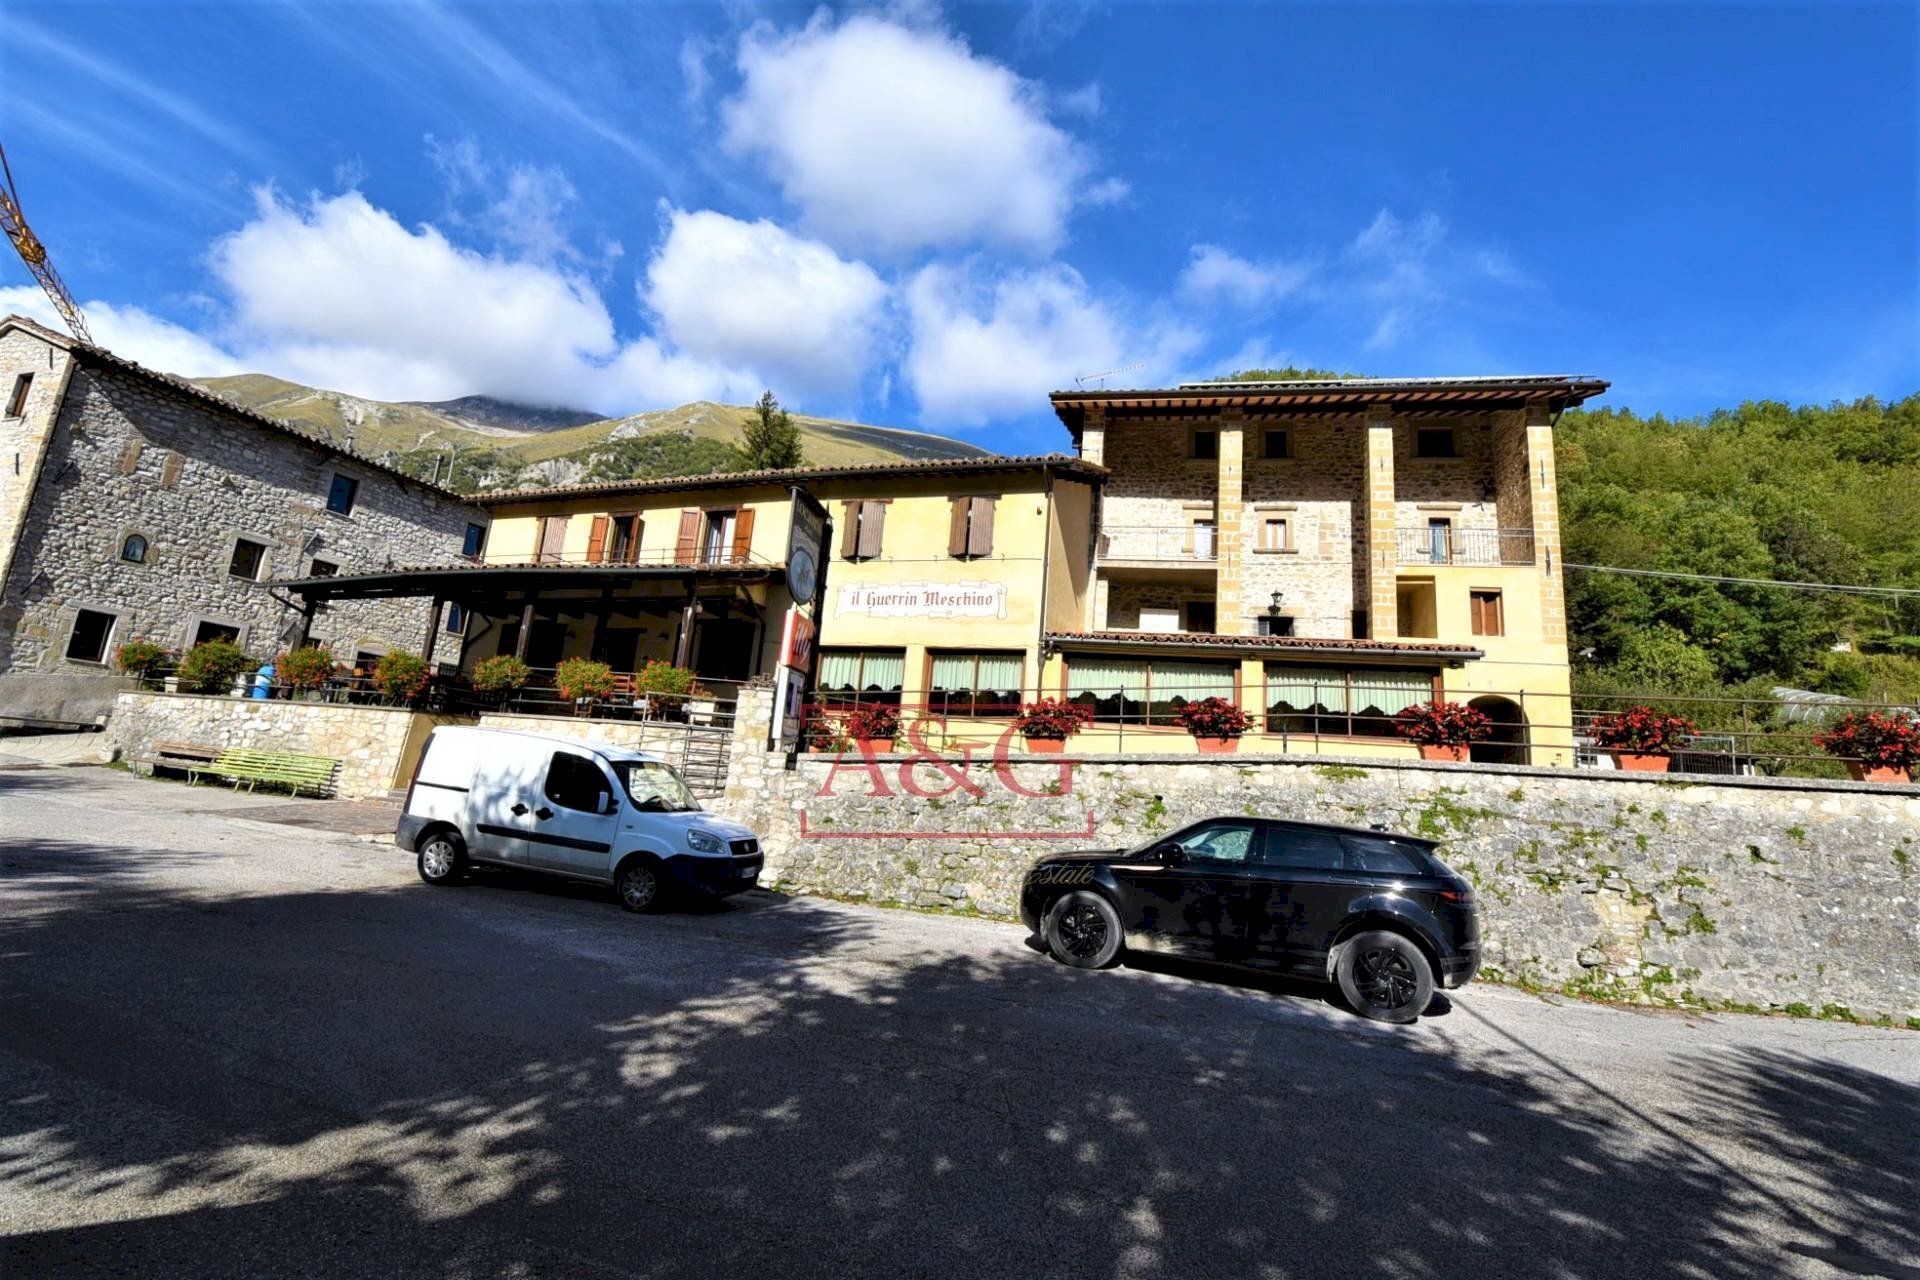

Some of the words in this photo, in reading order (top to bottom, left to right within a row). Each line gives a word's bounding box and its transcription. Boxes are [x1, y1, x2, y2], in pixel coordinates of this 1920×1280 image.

[851, 591, 860, 605] il
[866, 591, 918, 608] Guerrin
[922, 591, 993, 607] Meschino
